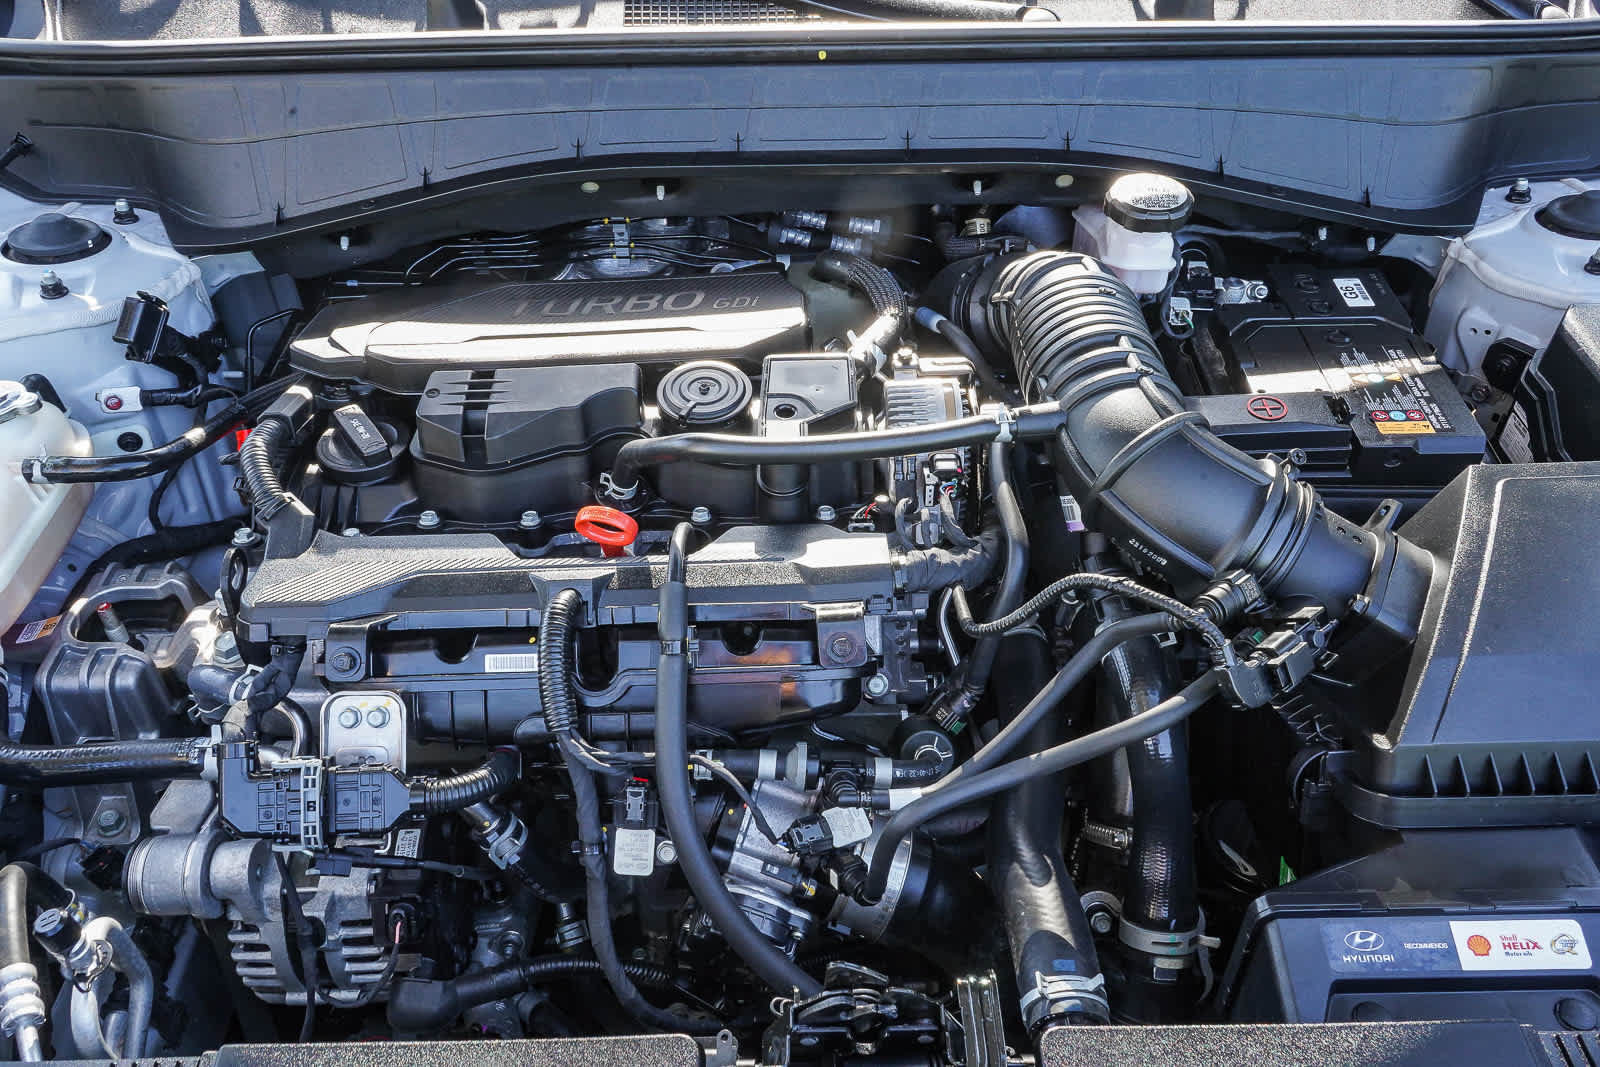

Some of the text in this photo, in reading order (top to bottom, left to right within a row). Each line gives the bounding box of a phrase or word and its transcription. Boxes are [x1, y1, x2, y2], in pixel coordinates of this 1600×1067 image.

[513, 291, 705, 317] TURBO
[1502, 939, 1543, 950] HELIX
[1342, 954, 1395, 963] HYUNDAI
